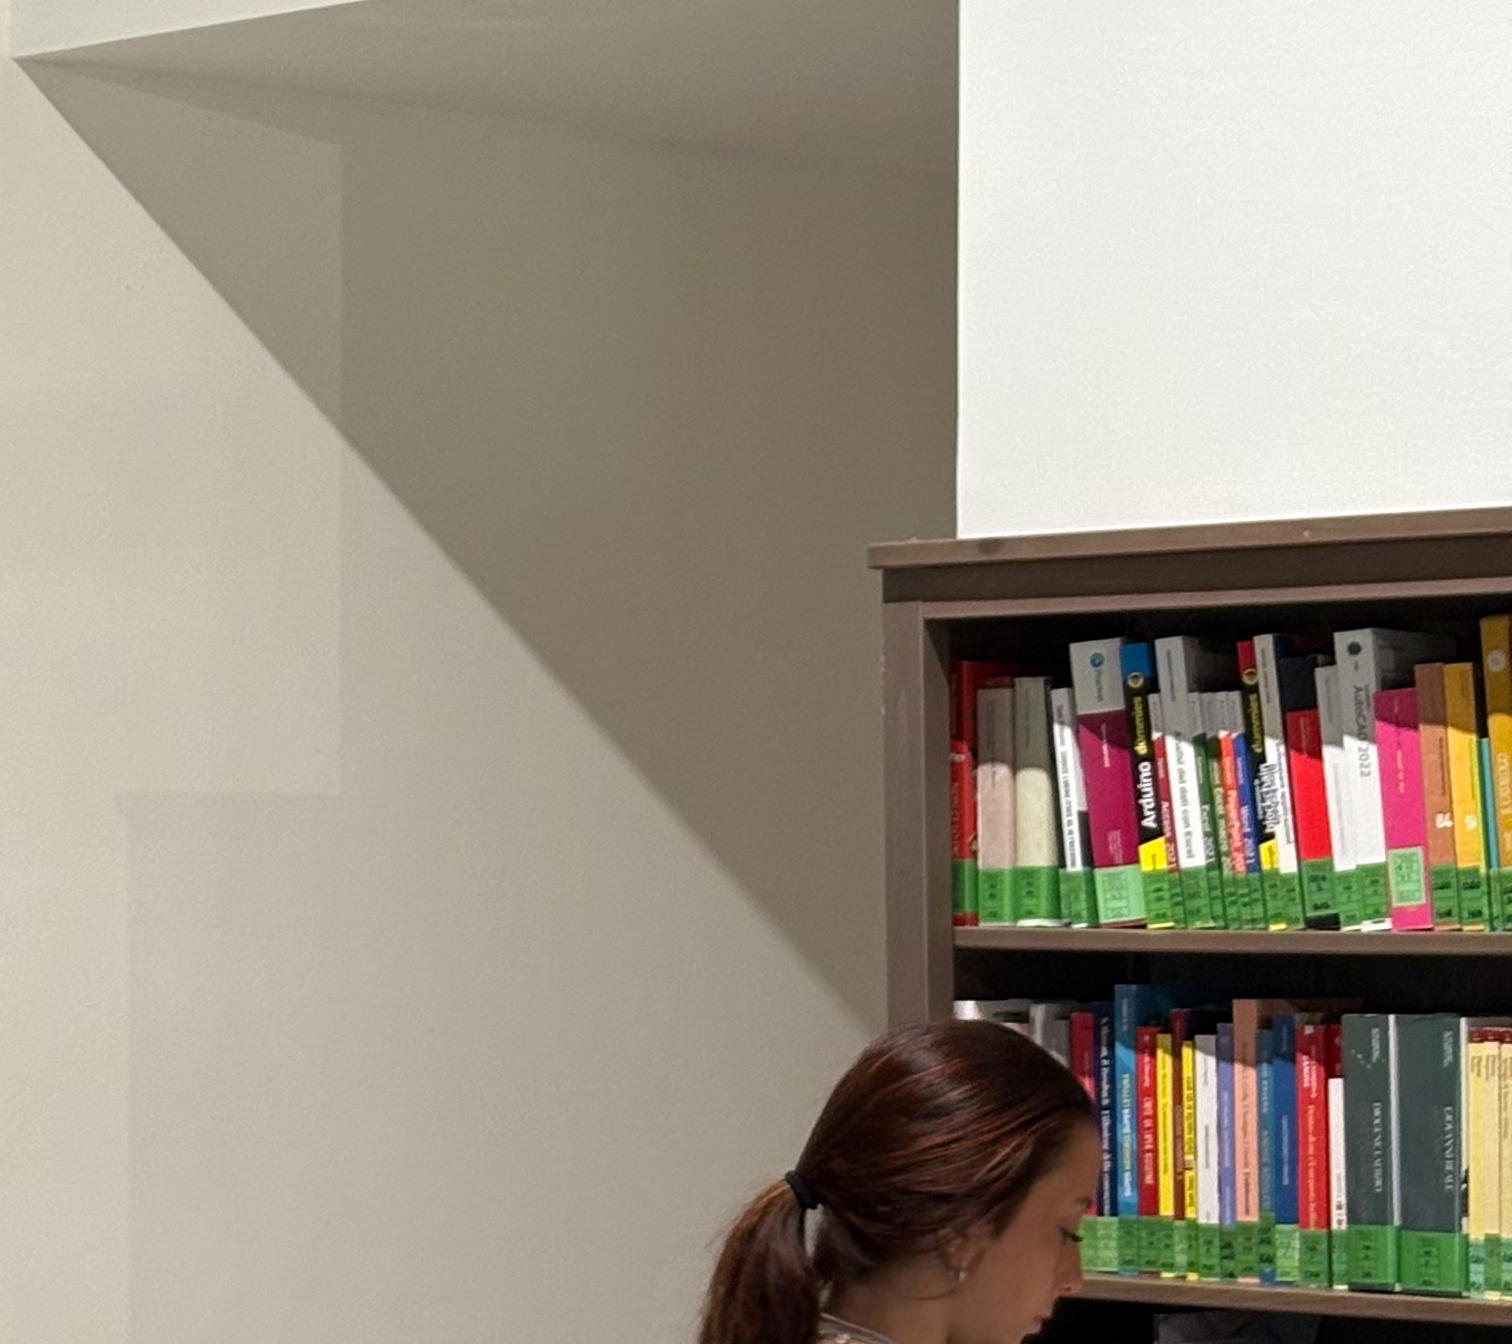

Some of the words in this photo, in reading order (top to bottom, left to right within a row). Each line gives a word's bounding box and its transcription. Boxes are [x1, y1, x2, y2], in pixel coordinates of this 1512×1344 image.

[1353, 685, 1369, 740] AutoCAD
[1358, 746, 1372, 778] 2022
[1138, 762, 1157, 828] Arduino
[1161, 801, 1172, 837] Access
[1201, 804, 1211, 832] Excel
[1183, 831, 1195, 859] Excel
